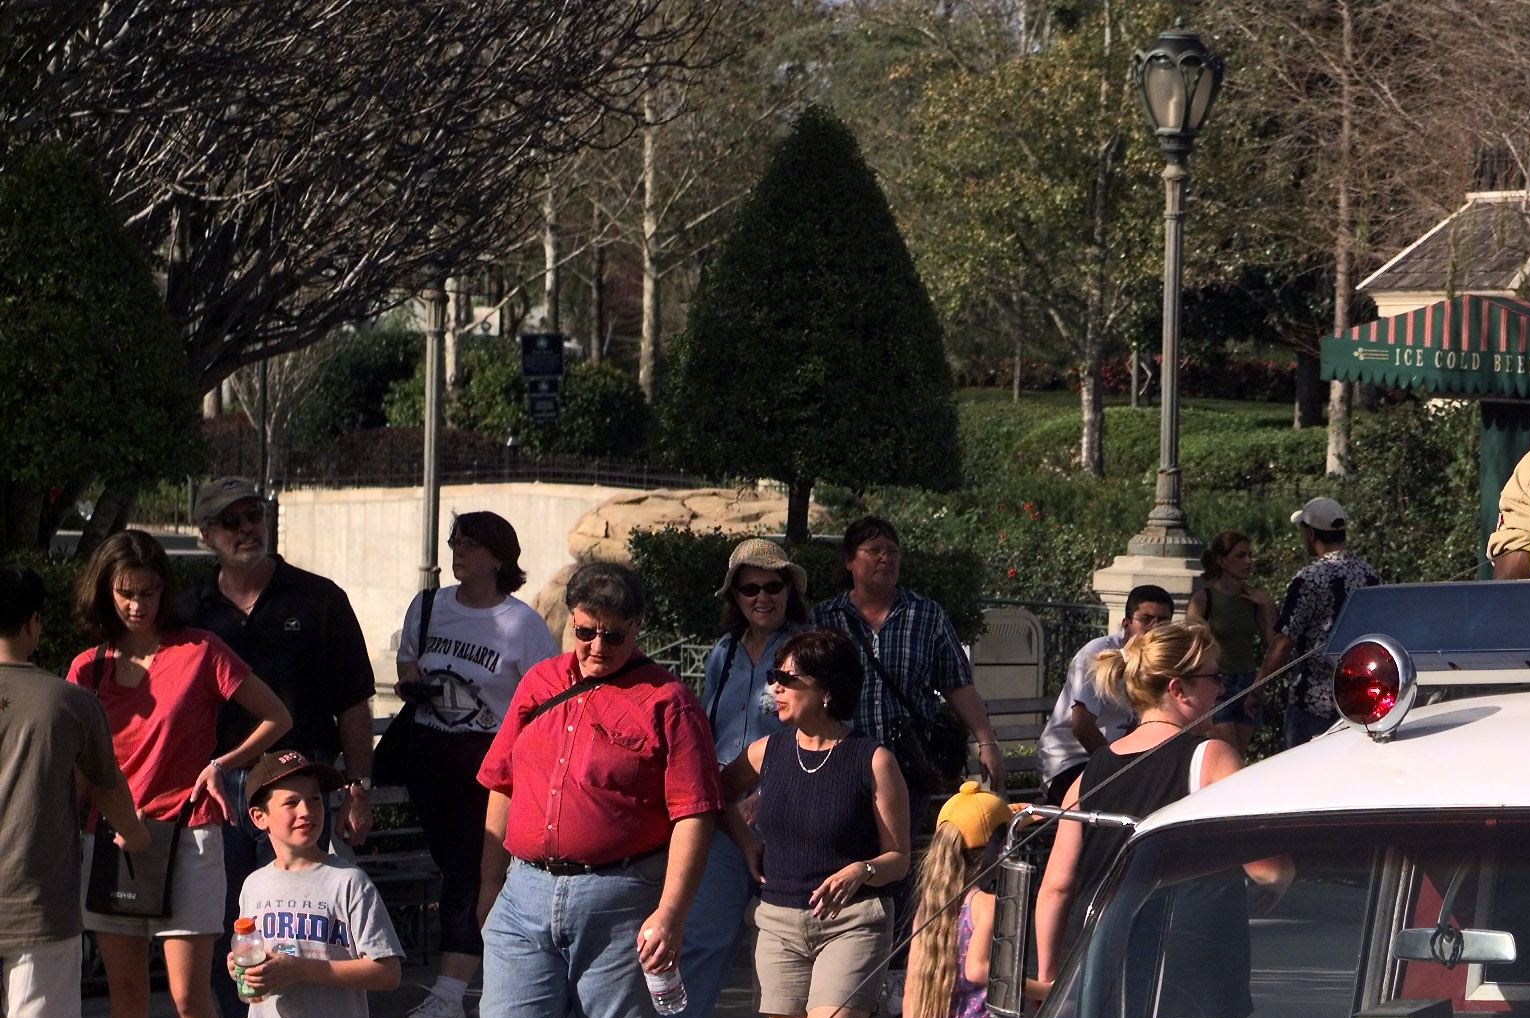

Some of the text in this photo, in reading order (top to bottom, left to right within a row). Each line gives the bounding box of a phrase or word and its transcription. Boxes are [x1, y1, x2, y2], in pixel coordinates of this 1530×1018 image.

[1395, 348, 1424, 367] ICE
[1434, 350, 1481, 370] COLD
[453, 641, 500, 673] VALLARTA
[256, 899, 328, 910] GATORS
[253, 911, 350, 948] ORIDA
